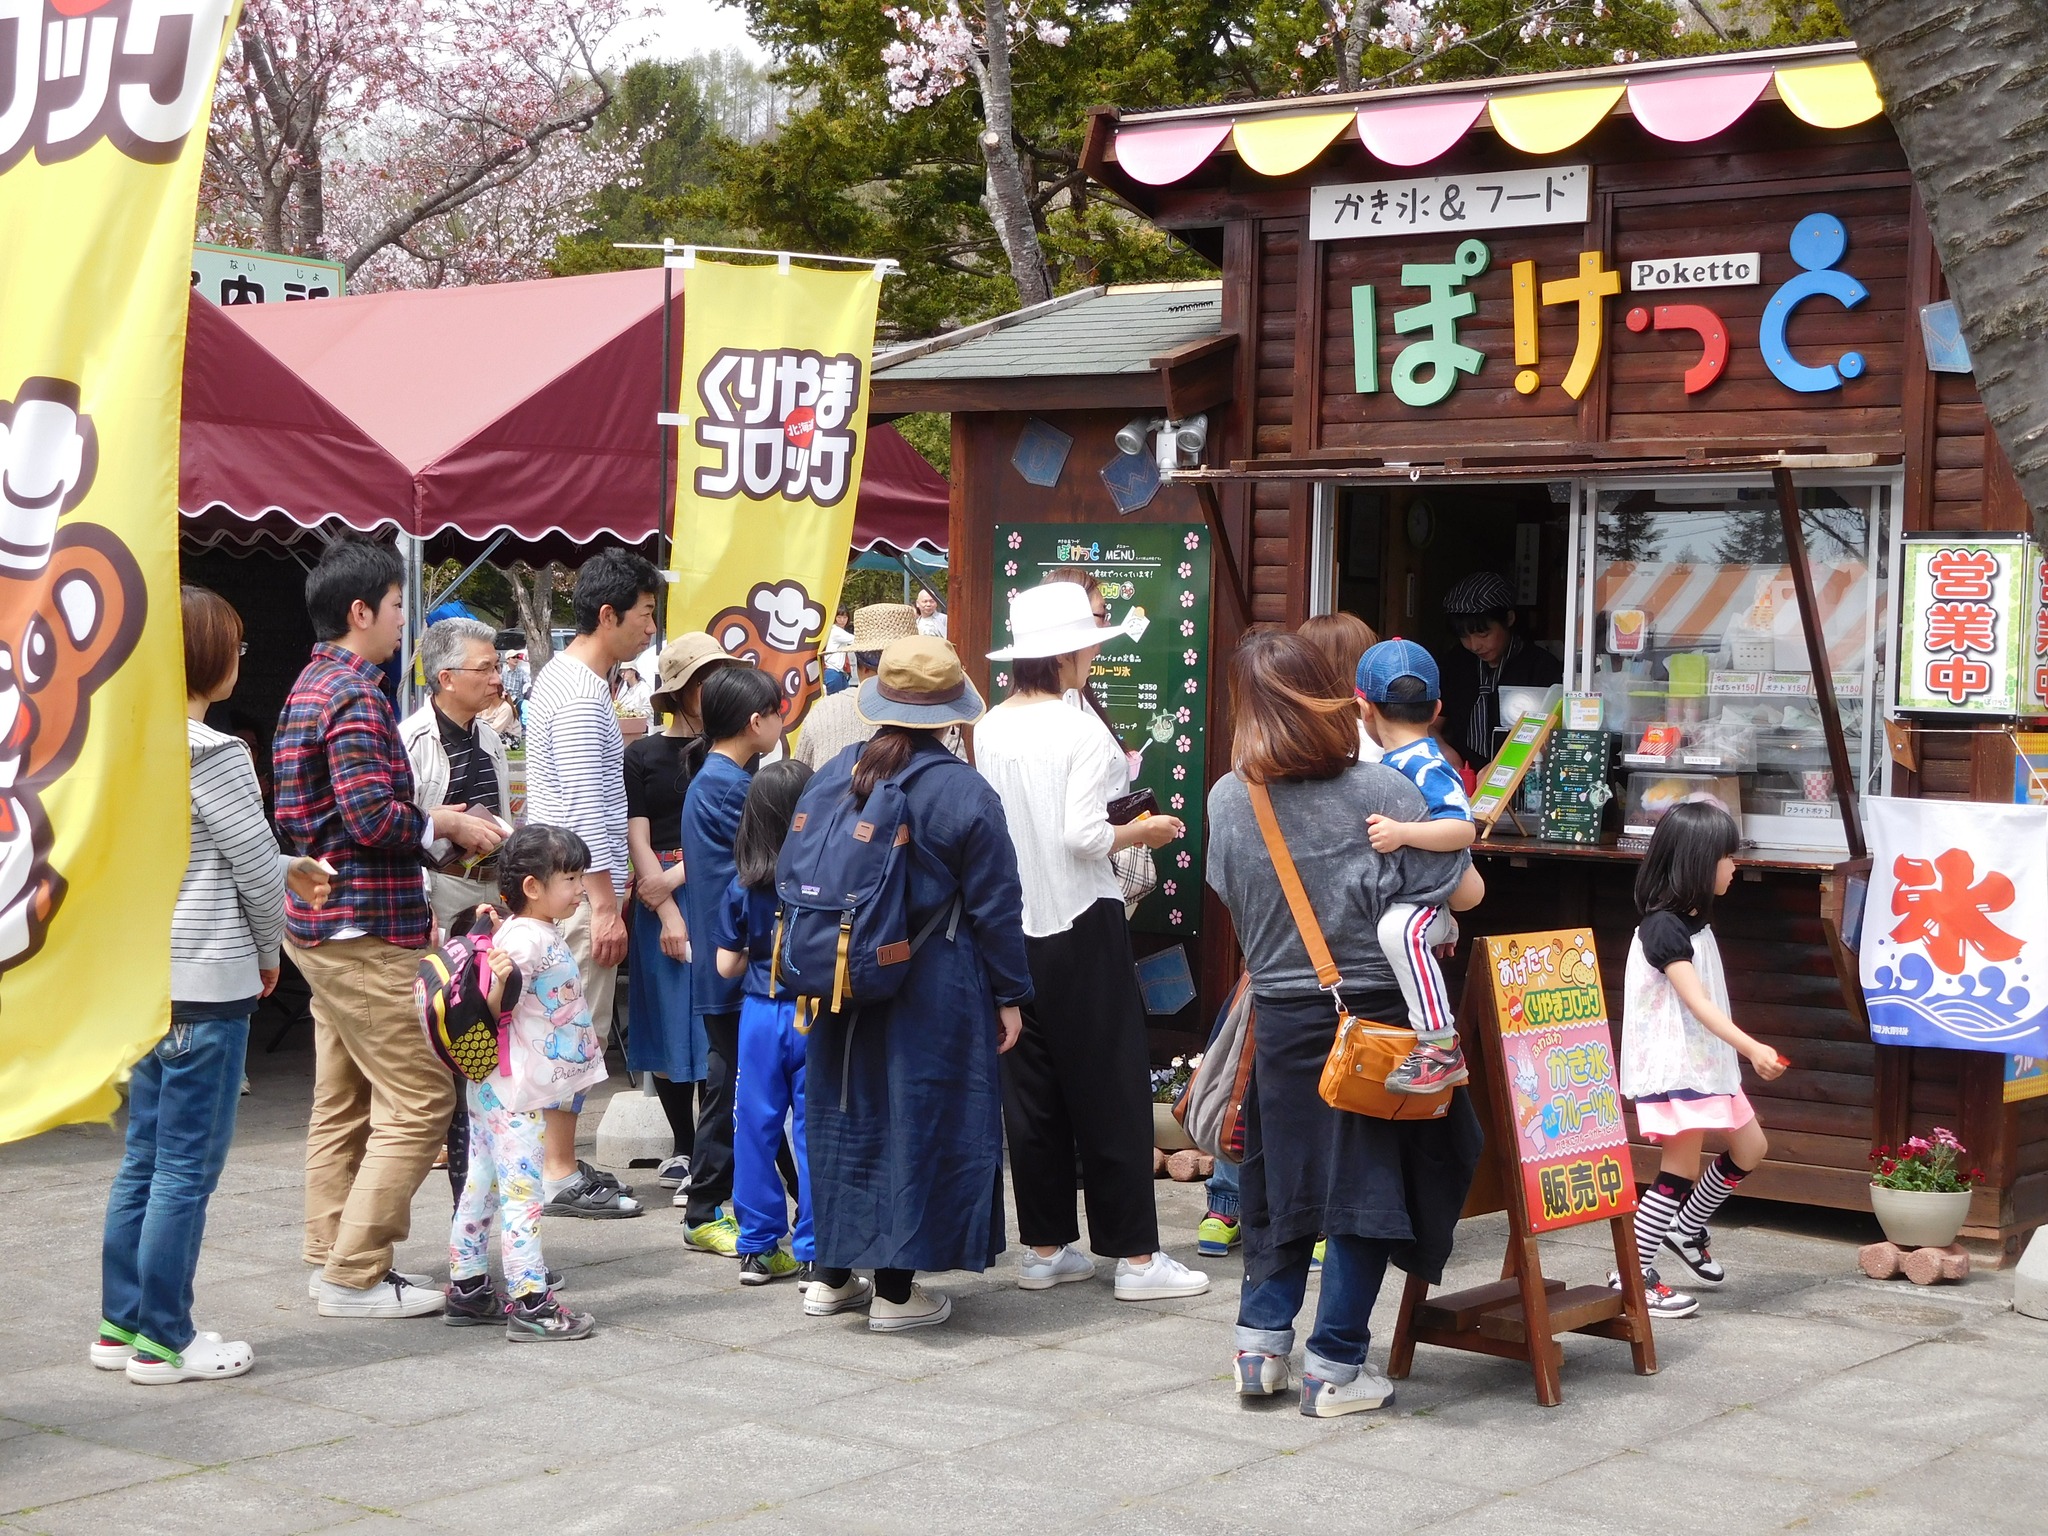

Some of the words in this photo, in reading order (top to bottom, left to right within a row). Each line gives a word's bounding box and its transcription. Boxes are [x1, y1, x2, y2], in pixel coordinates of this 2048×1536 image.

[1636, 258, 1752, 288] Poketto
[703, 355, 855, 430] くりやま
[701, 424, 850, 500] コロッケ
[1056, 542, 1100, 561] ぽけっと
[1105, 549, 1135, 561] MENU
[1926, 549, 1998, 704] 営業中
[1786, 806, 1830, 815] フライドポテト
[1890, 847, 2028, 975] 氷
[1497, 945, 1554, 987] あげたて
[1524, 986, 1600, 1024] くりやまコロッケ
[1531, 1031, 1563, 1059] ふわふわ
[1547, 1042, 1610, 1088] かき氷
[1552, 1087, 1618, 1133] フルーツ氷
[1540, 1156, 1622, 1220] 販売中
